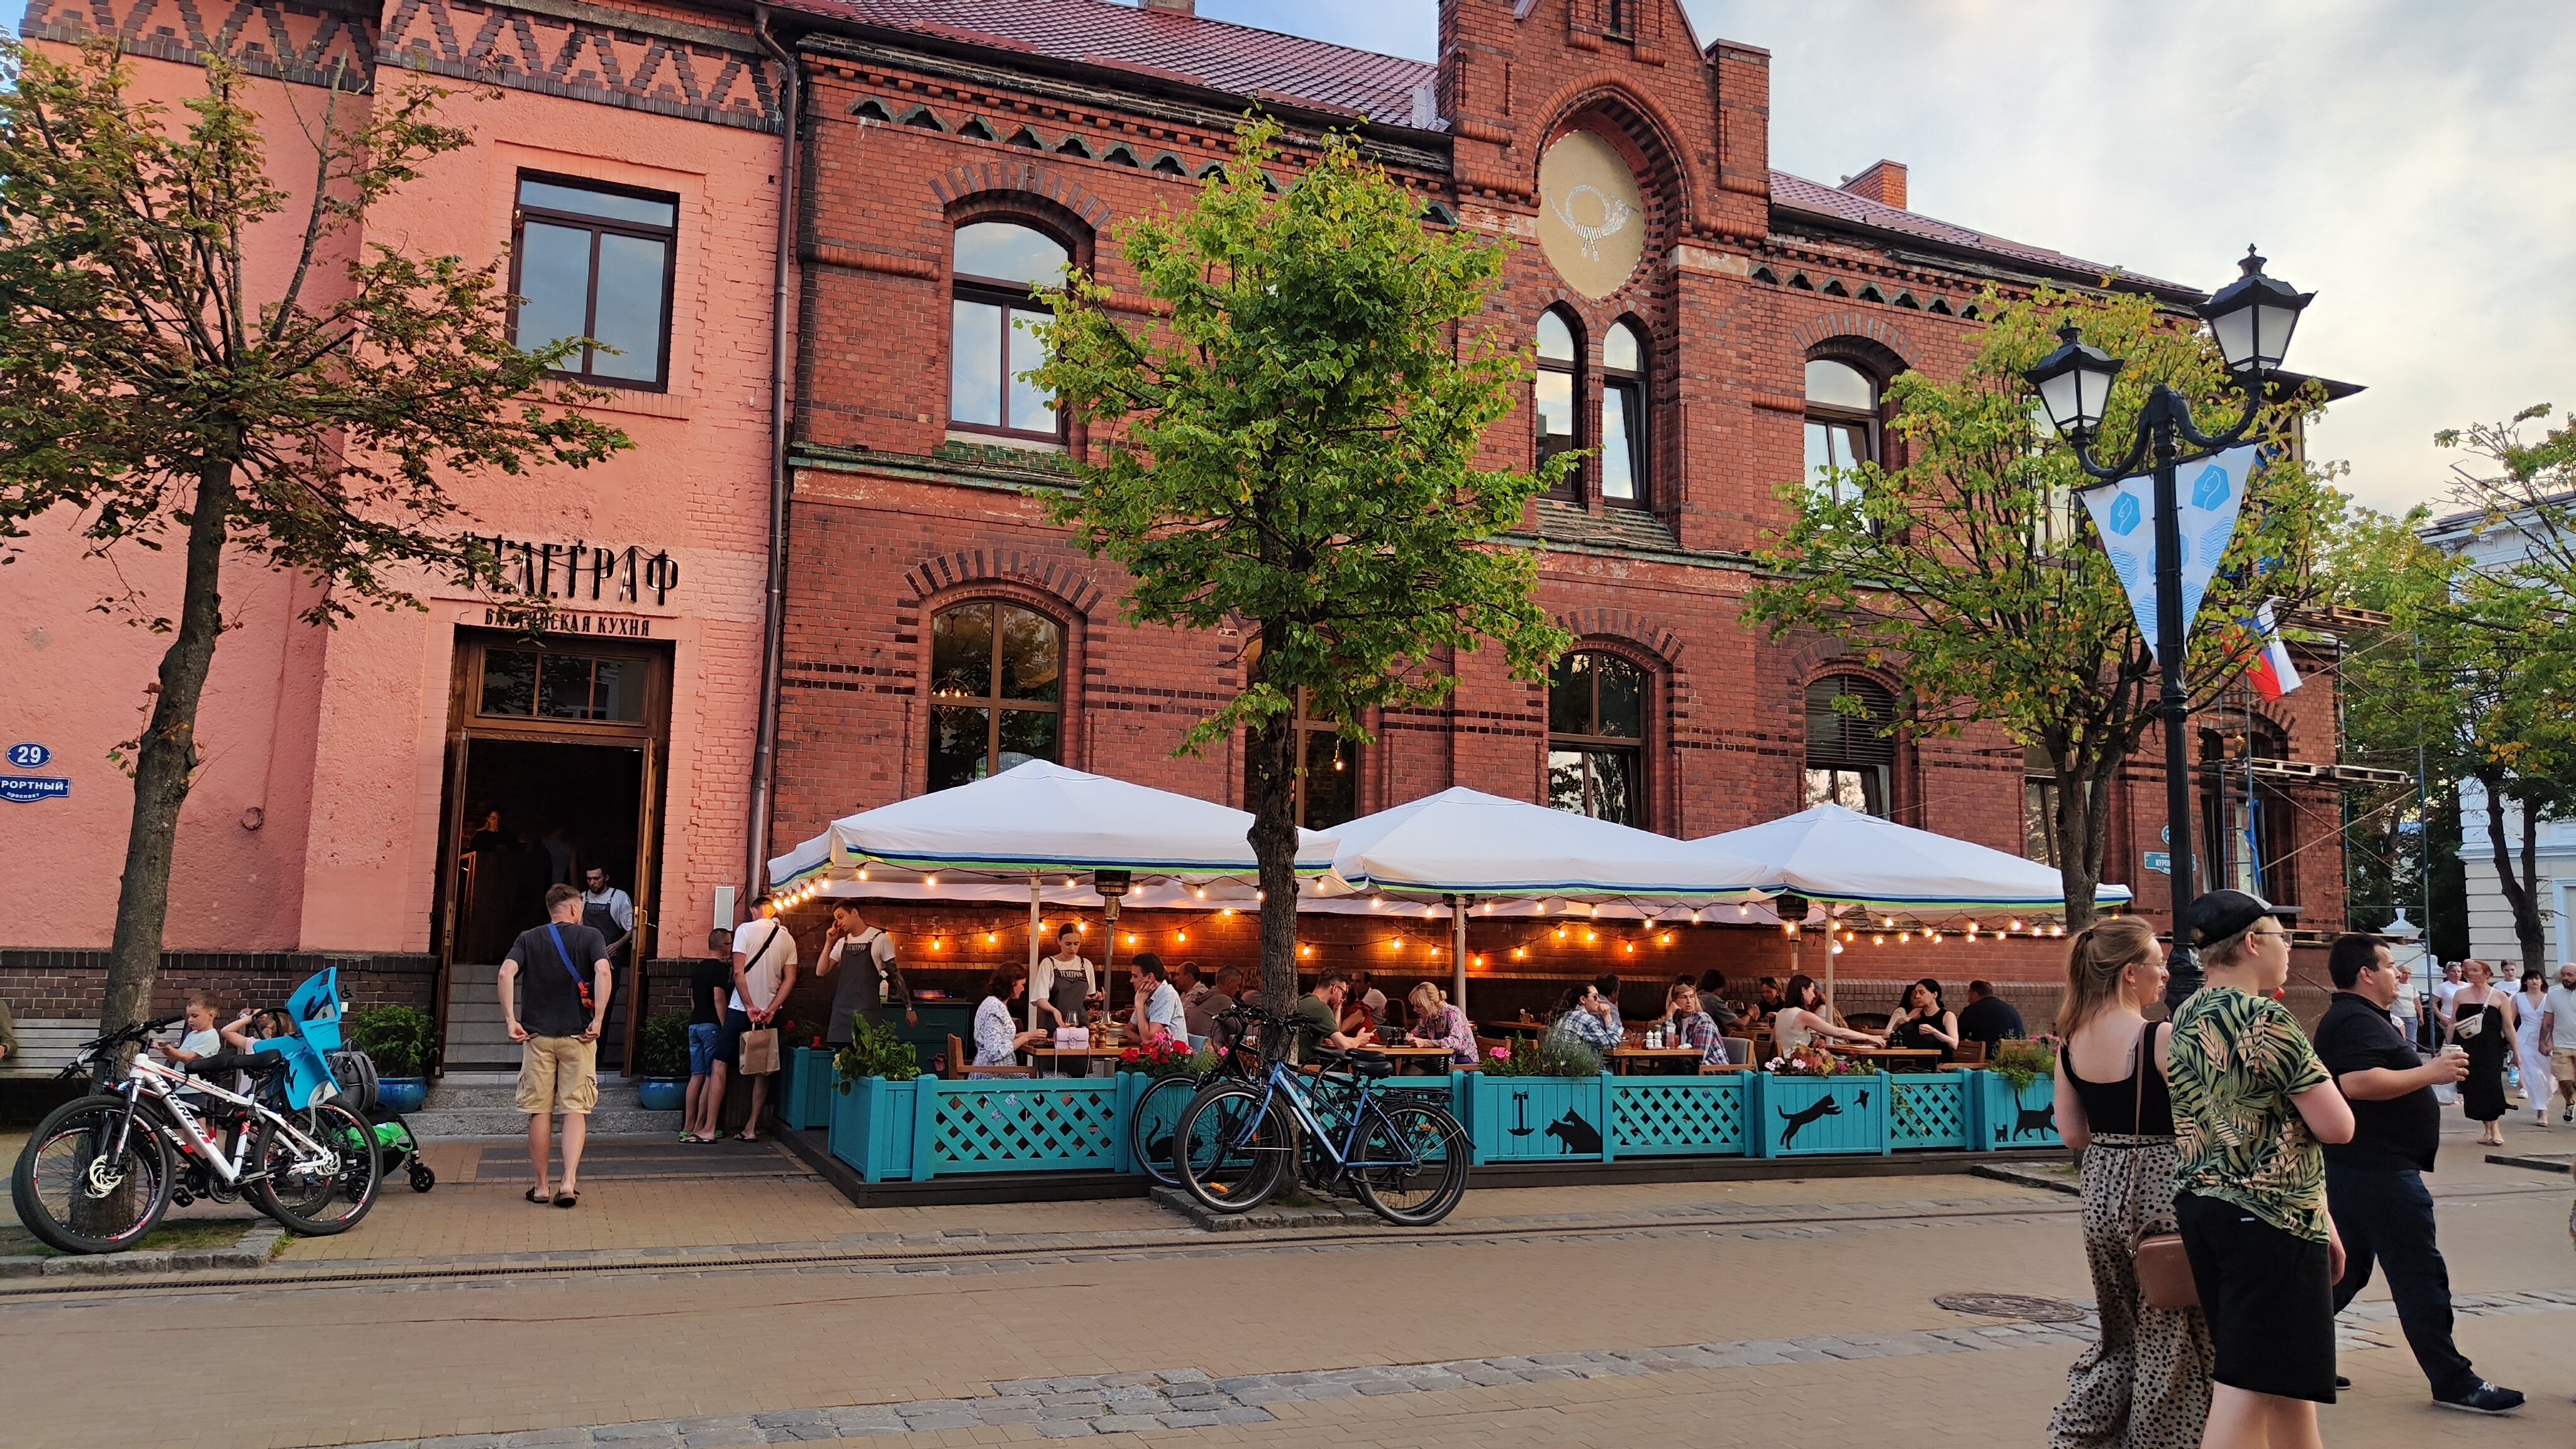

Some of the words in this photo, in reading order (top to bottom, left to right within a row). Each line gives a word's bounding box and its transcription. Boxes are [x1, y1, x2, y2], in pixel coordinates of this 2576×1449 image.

[597, 616, 650, 636] КУХНЯ
[17, 746, 42, 763] 29
[0, 780, 64, 791] РОРТНЫЙ
